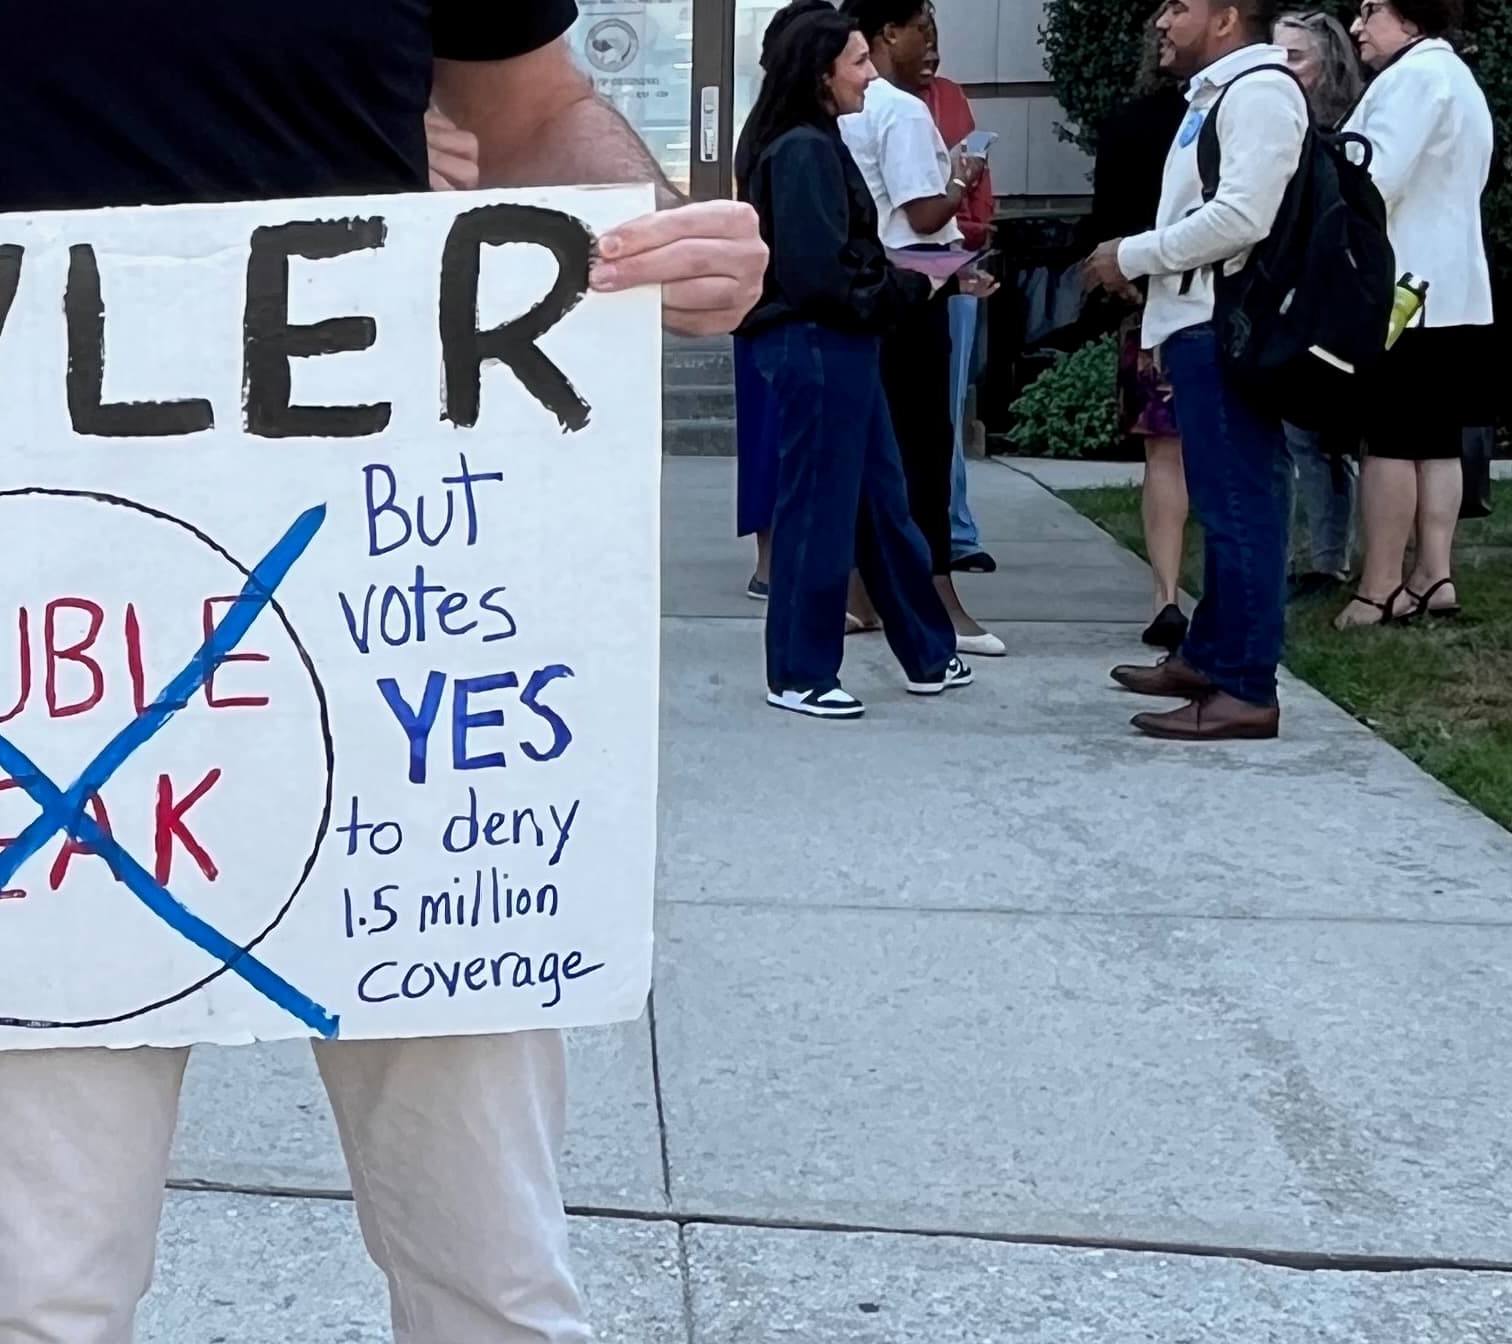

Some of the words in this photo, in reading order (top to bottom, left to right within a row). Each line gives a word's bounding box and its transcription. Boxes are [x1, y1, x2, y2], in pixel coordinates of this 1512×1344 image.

[361, 453, 504, 556] But
[338, 565, 518, 655] votes
[376, 663, 575, 785] YES
[336, 795, 403, 856] to
[442, 786, 580, 866] deny
[344, 884, 399, 938] 1.5
[418, 866, 559, 934] million
[357, 951, 605, 1008] coverage
